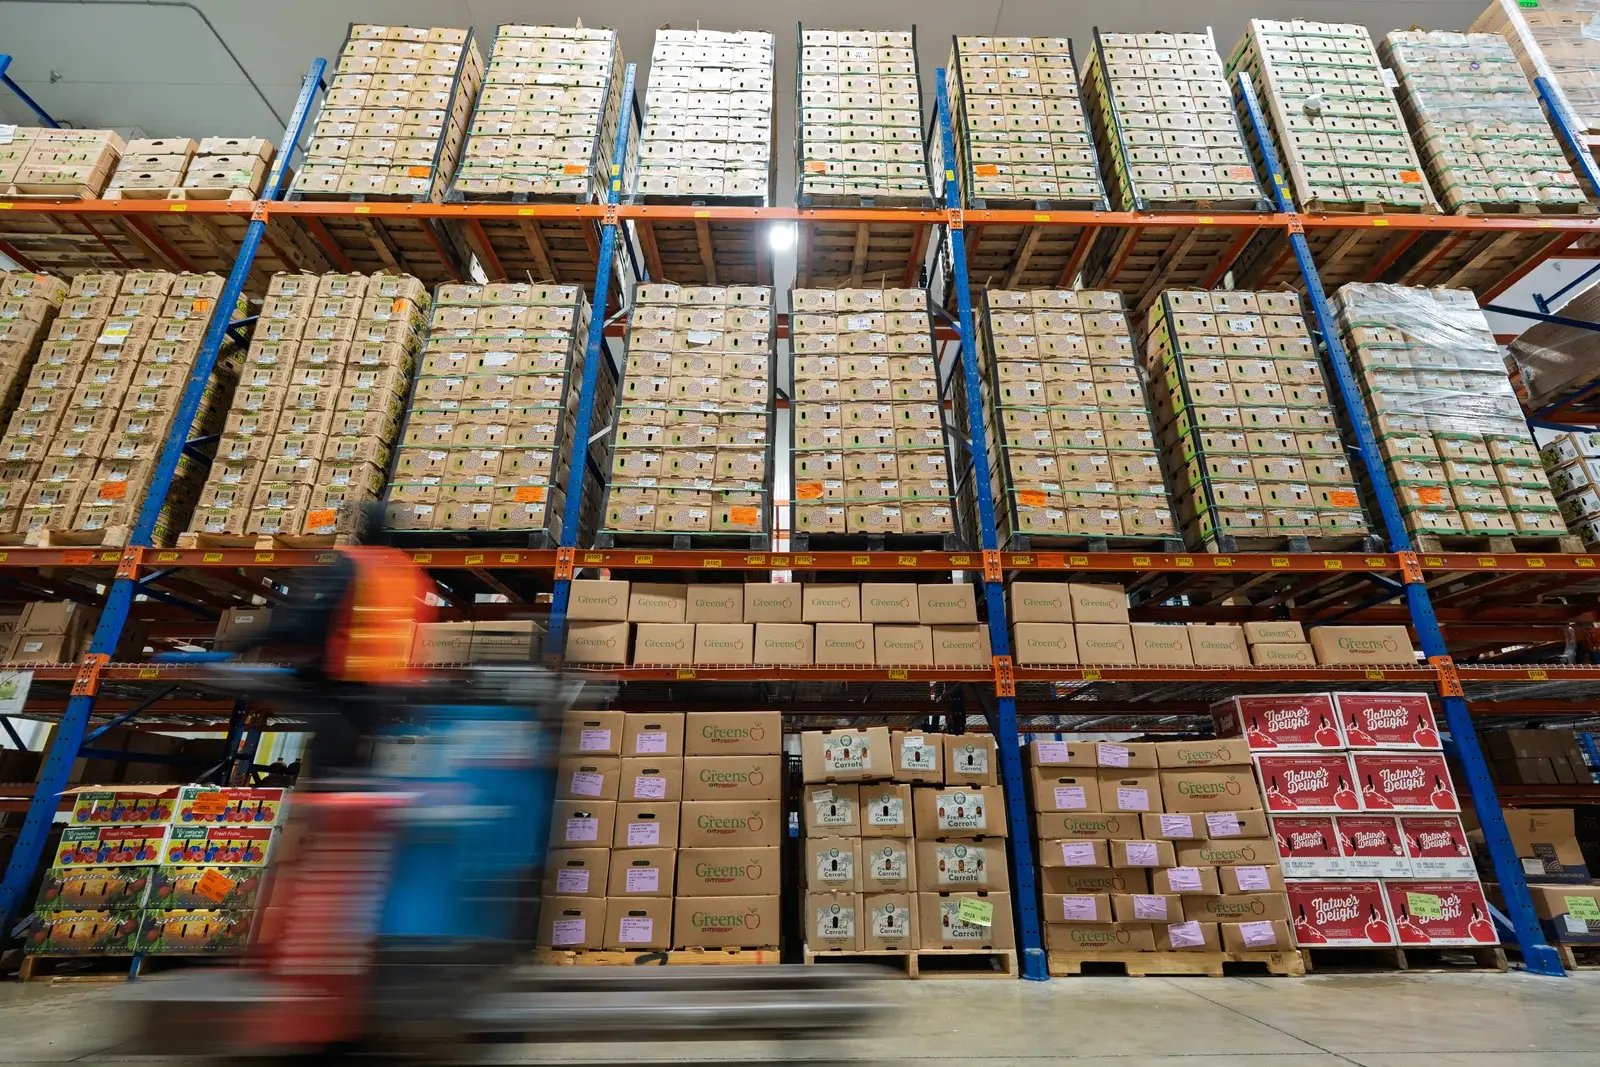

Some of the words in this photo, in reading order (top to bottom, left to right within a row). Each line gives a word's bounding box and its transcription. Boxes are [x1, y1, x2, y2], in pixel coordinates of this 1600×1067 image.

[578, 595, 607, 604] Greens
[638, 598, 668, 607] Greens
[695, 599, 724, 607] Greens
[753, 598, 782, 607] Greens
[812, 598, 841, 607] Greens
[870, 598, 900, 607] Greens
[928, 599, 957, 608] Greens
[1023, 598, 1052, 607] Greens
[1080, 599, 1109, 607] Greens
[1259, 629, 1286, 638] Greens
[421, 639, 452, 647] Greens
[576, 637, 606, 646] Greens
[645, 639, 675, 648] Greens
[704, 639, 734, 648] Greens
[765, 639, 795, 648] Greens
[825, 639, 855, 648] Greens
[884, 640, 914, 649] Greens
[942, 641, 972, 649] Greens
[1028, 638, 1057, 648] Greens
[1086, 640, 1115, 648] Greens
[1144, 640, 1173, 648] Greens
[1201, 640, 1229, 649] Greens
[1338, 637, 1383, 650] Greens
[1267, 651, 1297, 660] Greens
[1264, 707, 1310, 722] Nature's
[1363, 706, 1408, 721] Nature's
[1268, 717, 1311, 732] Delight
[1367, 716, 1409, 731] Delight
[702, 725, 748, 738] Greens
[1177, 750, 1218, 760] Greens
[700, 769, 747, 782] Greens
[1283, 766, 1329, 782] Nature's
[1379, 766, 1425, 781] Nature's
[1178, 780, 1225, 794] Greens
[1287, 776, 1329, 794] Delight
[1383, 776, 1426, 793] Delight
[697, 815, 746, 828] Greens
[1064, 818, 1106, 831] Greens
[1291, 831, 1322, 841] Nature's
[1355, 830, 1386, 841] Nature's
[1419, 831, 1450, 841] Nature's
[1293, 838, 1322, 849] Delight
[1357, 837, 1386, 848] Delight
[1423, 838, 1451, 849] Delight
[1199, 848, 1242, 859] Greens
[695, 863, 745, 876] Greens
[54, 874, 106, 885] SIERRA
[110, 874, 138, 883] SUN
[166, 872, 204, 883] SIER
[1067, 874, 1111, 888] Greens
[1206, 900, 1250, 913] Greens
[1311, 894, 1359, 911] Nature's
[154, 915, 208, 926] SIERRA
[210, 916, 239, 925] SUN
[692, 912, 743, 926] Greens
[1316, 905, 1360, 925] Delight
[44, 916, 95, 927] SIERRA
[101, 916, 128, 925] SUN
[1071, 929, 1115, 942] Greens
